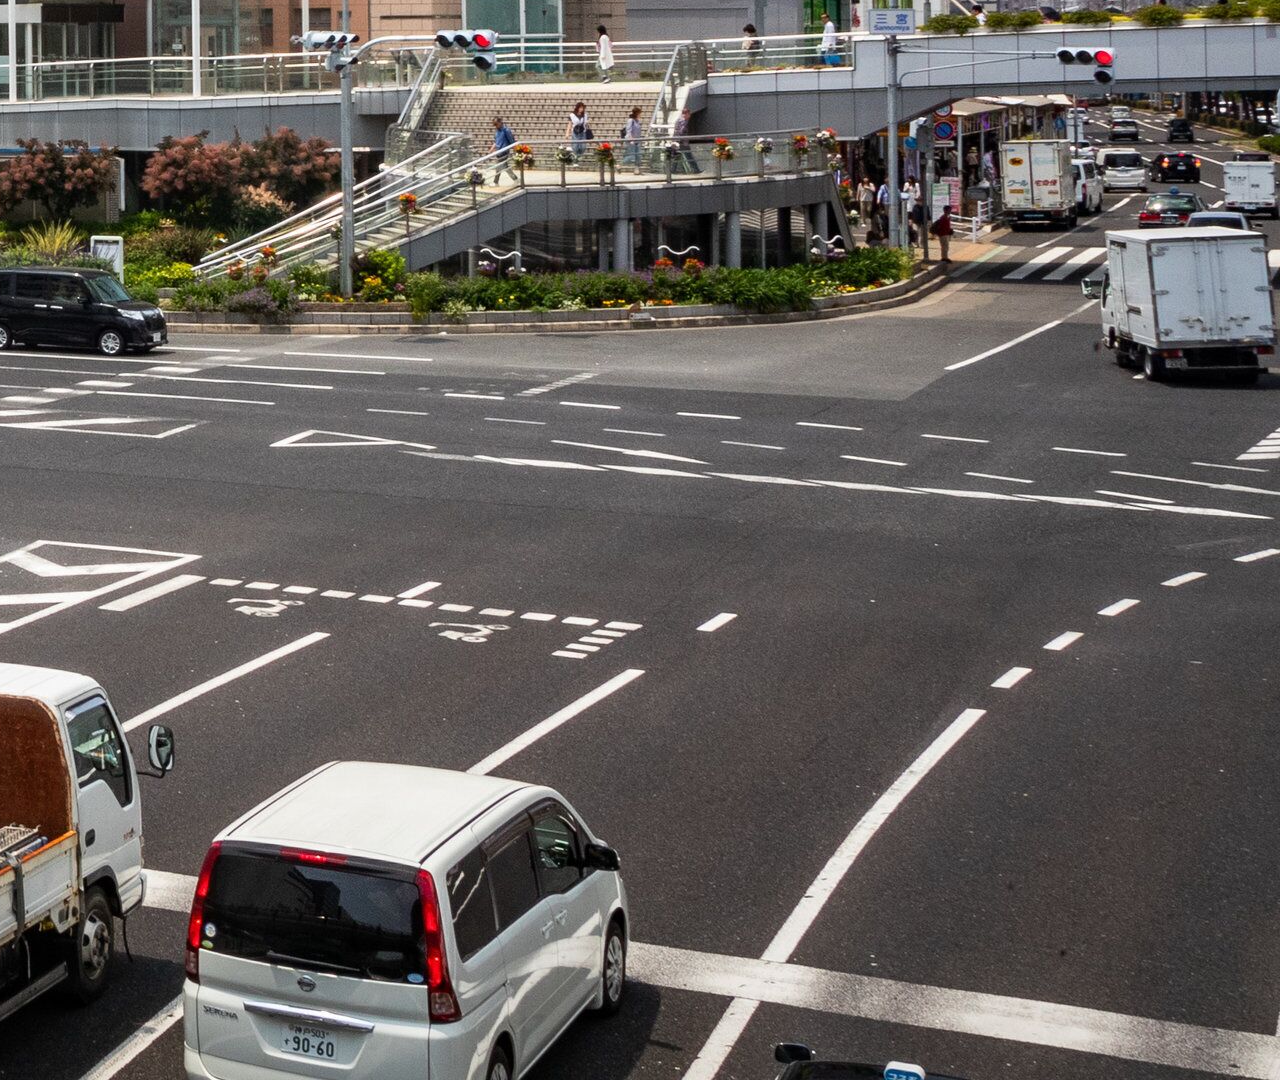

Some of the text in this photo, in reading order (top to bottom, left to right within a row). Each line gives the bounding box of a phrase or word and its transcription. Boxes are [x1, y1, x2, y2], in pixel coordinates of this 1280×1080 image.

[875, 13, 909, 25] 三宮
[873, 24, 911, 33] Sannomiya
[202, 1004, 239, 1020] SERENA
[292, 1036, 335, 1058] 90-60
